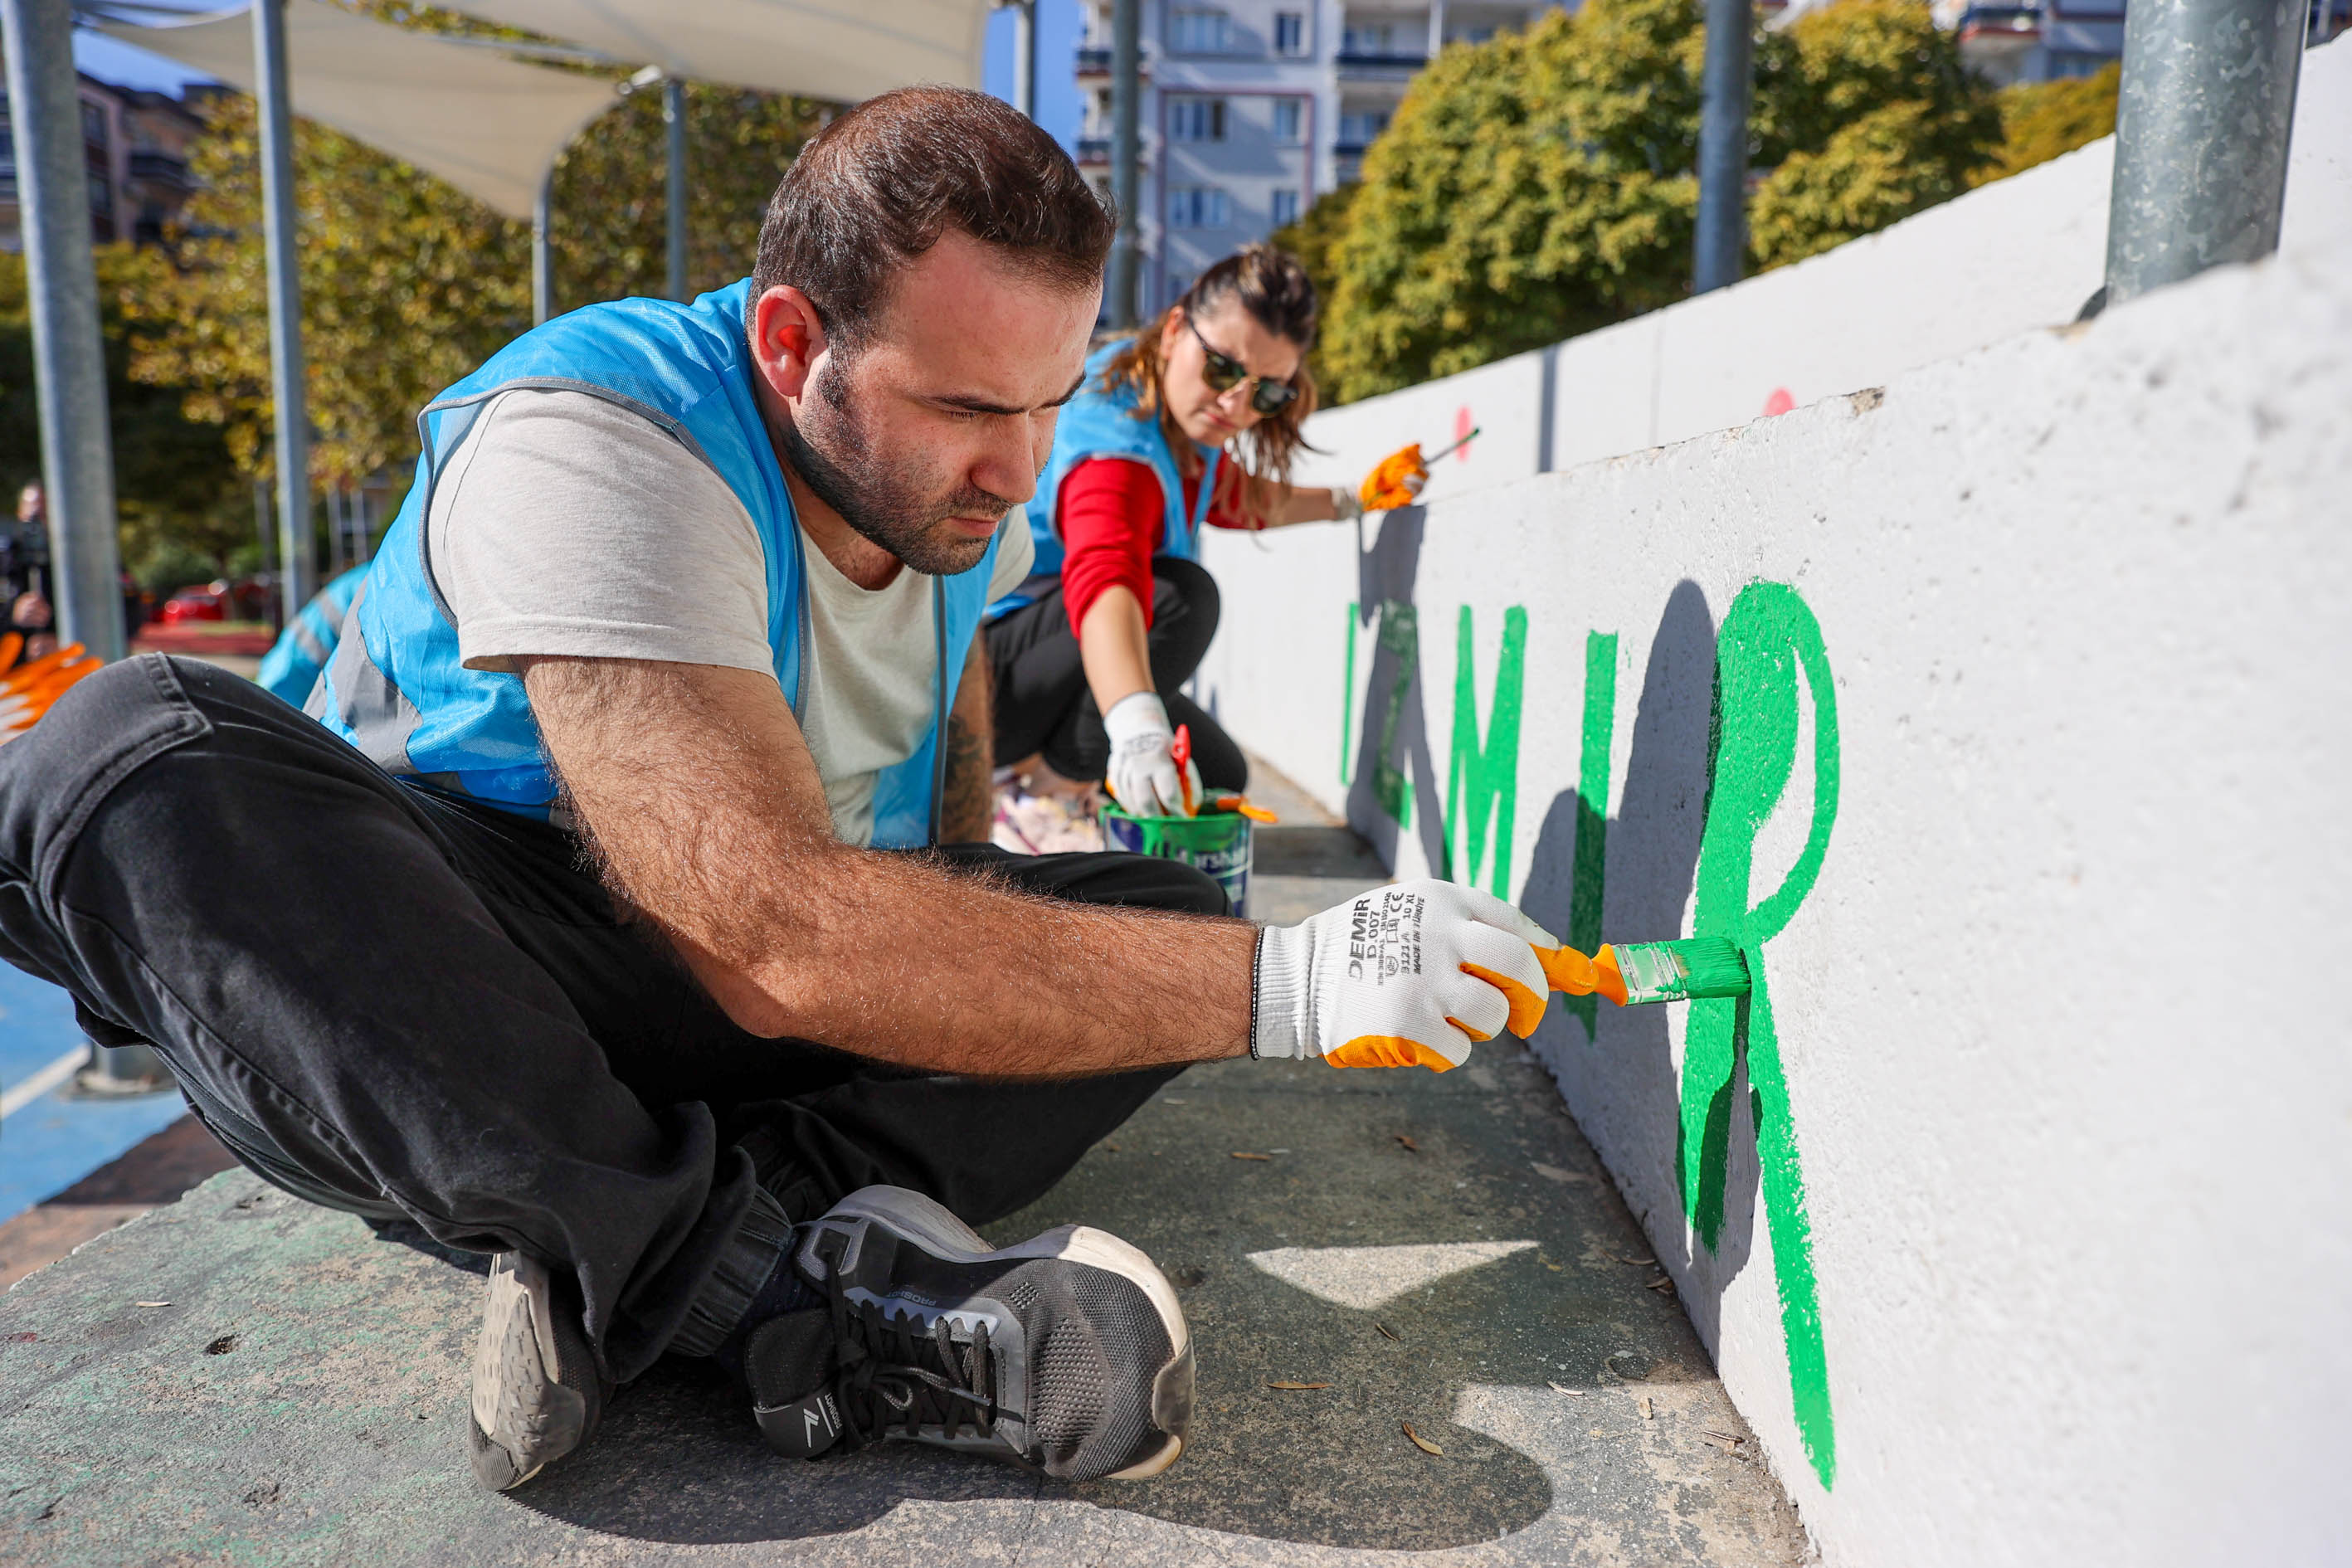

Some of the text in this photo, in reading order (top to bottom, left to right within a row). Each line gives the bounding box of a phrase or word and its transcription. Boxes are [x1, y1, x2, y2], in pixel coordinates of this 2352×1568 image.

[1403, 908, 1412, 919] 10
[1406, 894, 1415, 903] XL
[1366, 911, 1381, 959] D.007
[1413, 943, 1421, 974] MADE
[824, 1392, 843, 1429] PROSHOT
